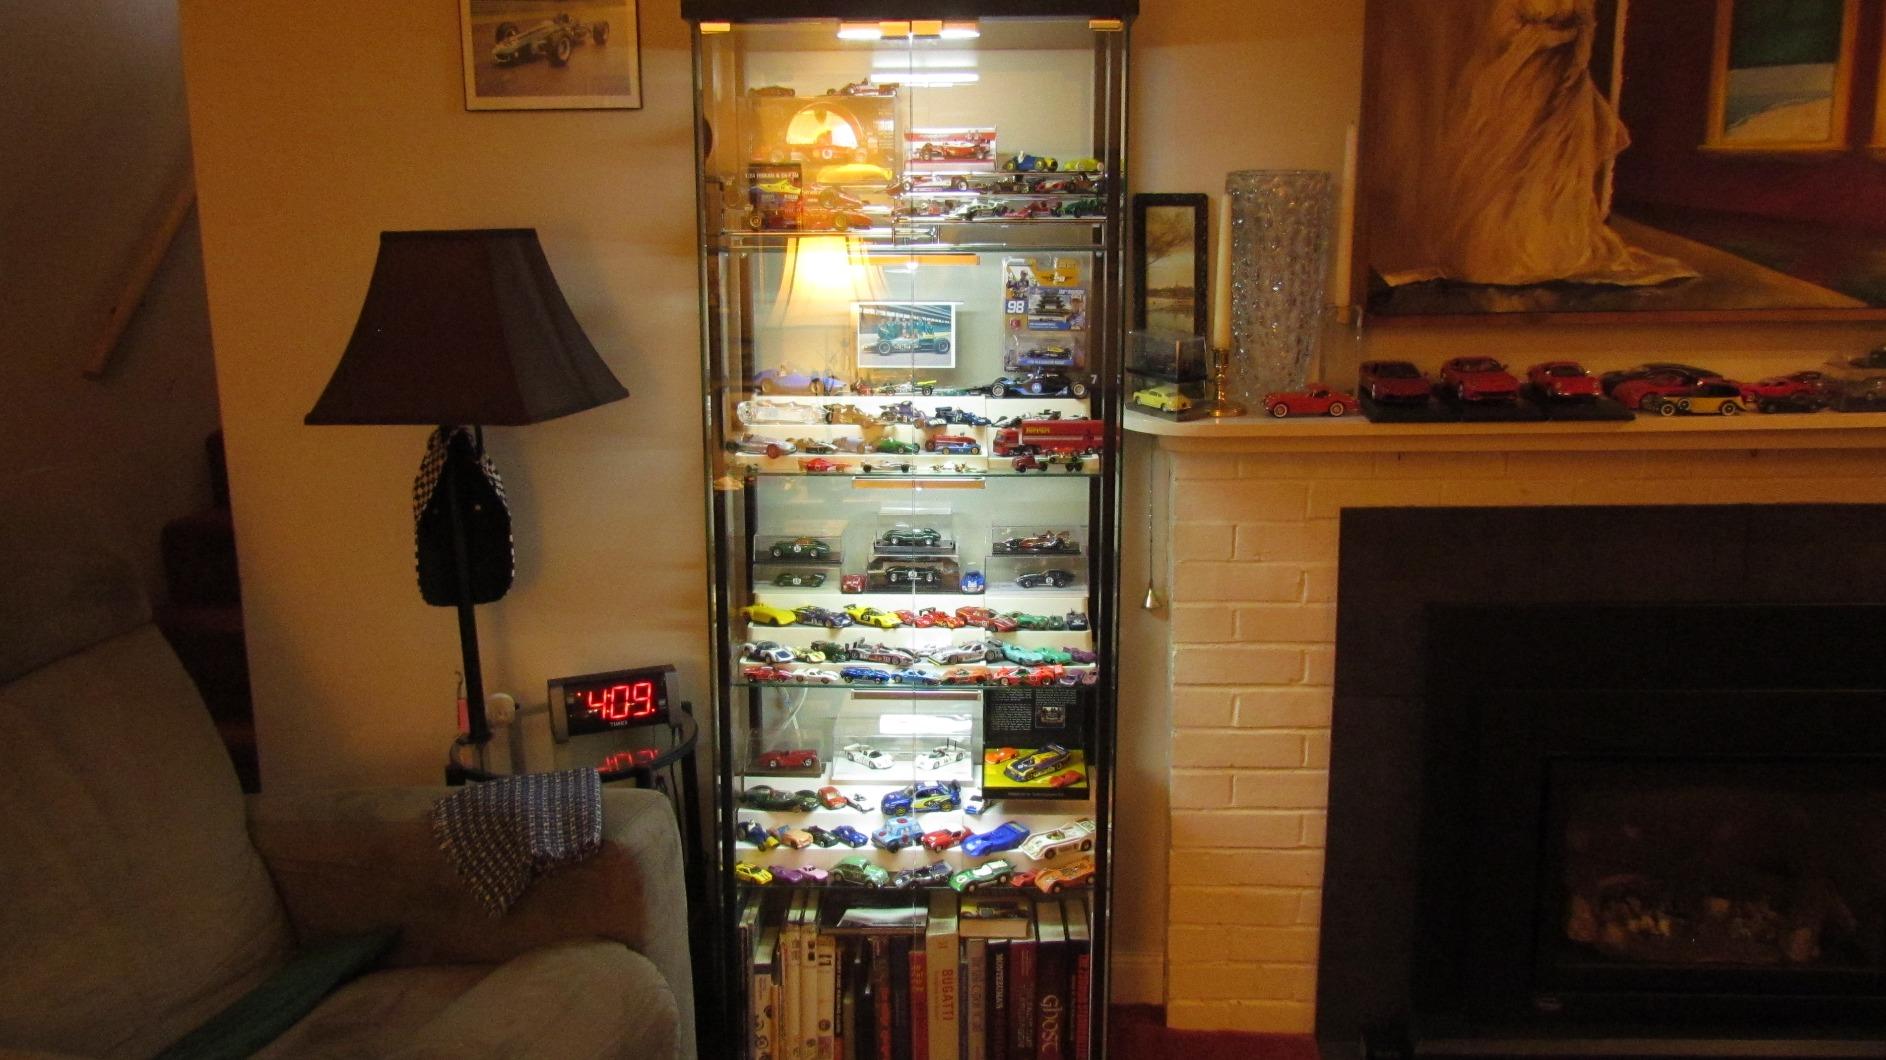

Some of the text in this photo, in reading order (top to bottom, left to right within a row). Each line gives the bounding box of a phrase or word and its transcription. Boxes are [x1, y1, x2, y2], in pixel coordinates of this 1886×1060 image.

[1007, 300, 1025, 313] 98
[588, 681, 652, 720] 4:09
[942, 968, 954, 1021] BUGATTI
